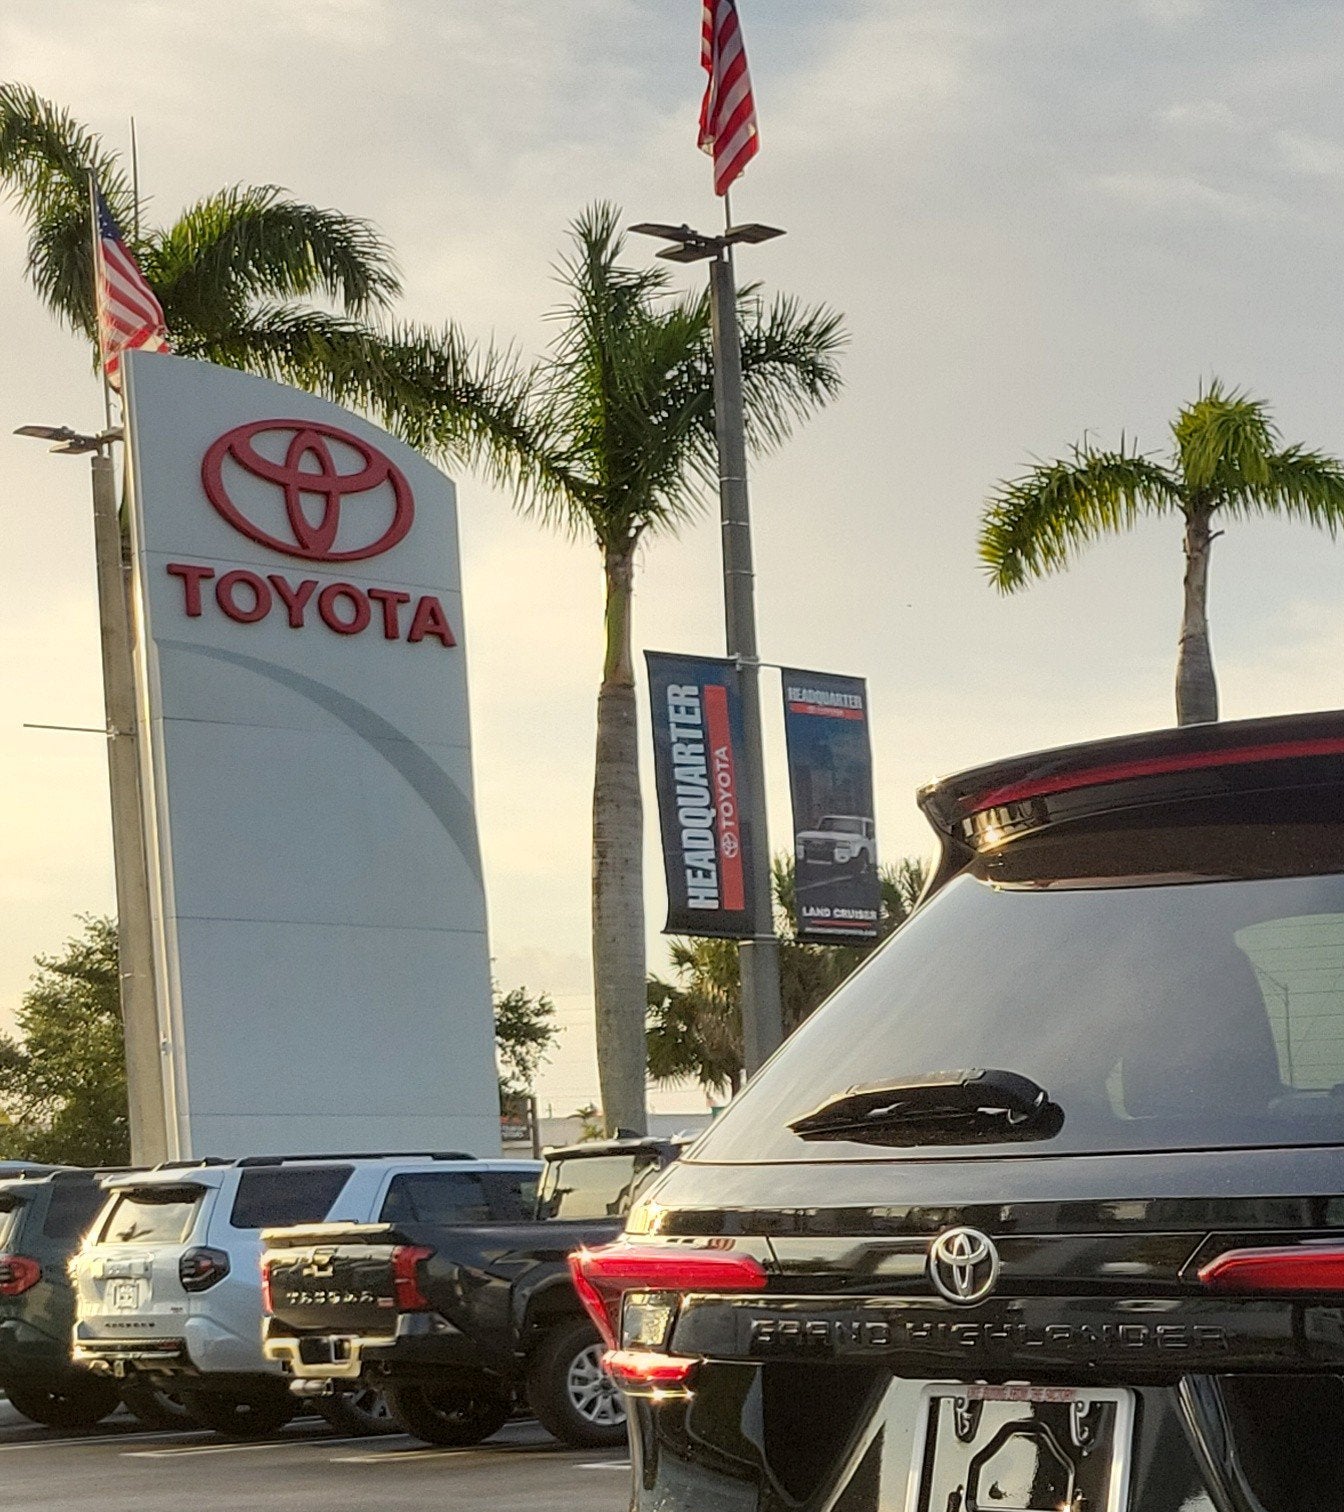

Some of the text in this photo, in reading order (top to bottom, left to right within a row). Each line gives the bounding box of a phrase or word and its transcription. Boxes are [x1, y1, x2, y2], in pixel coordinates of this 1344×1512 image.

[166, 562, 457, 647] TOYOTA
[667, 684, 720, 910] HEADQUARTER
[714, 746, 735, 829] TOYOTA
[802, 906, 831, 918] LAND
